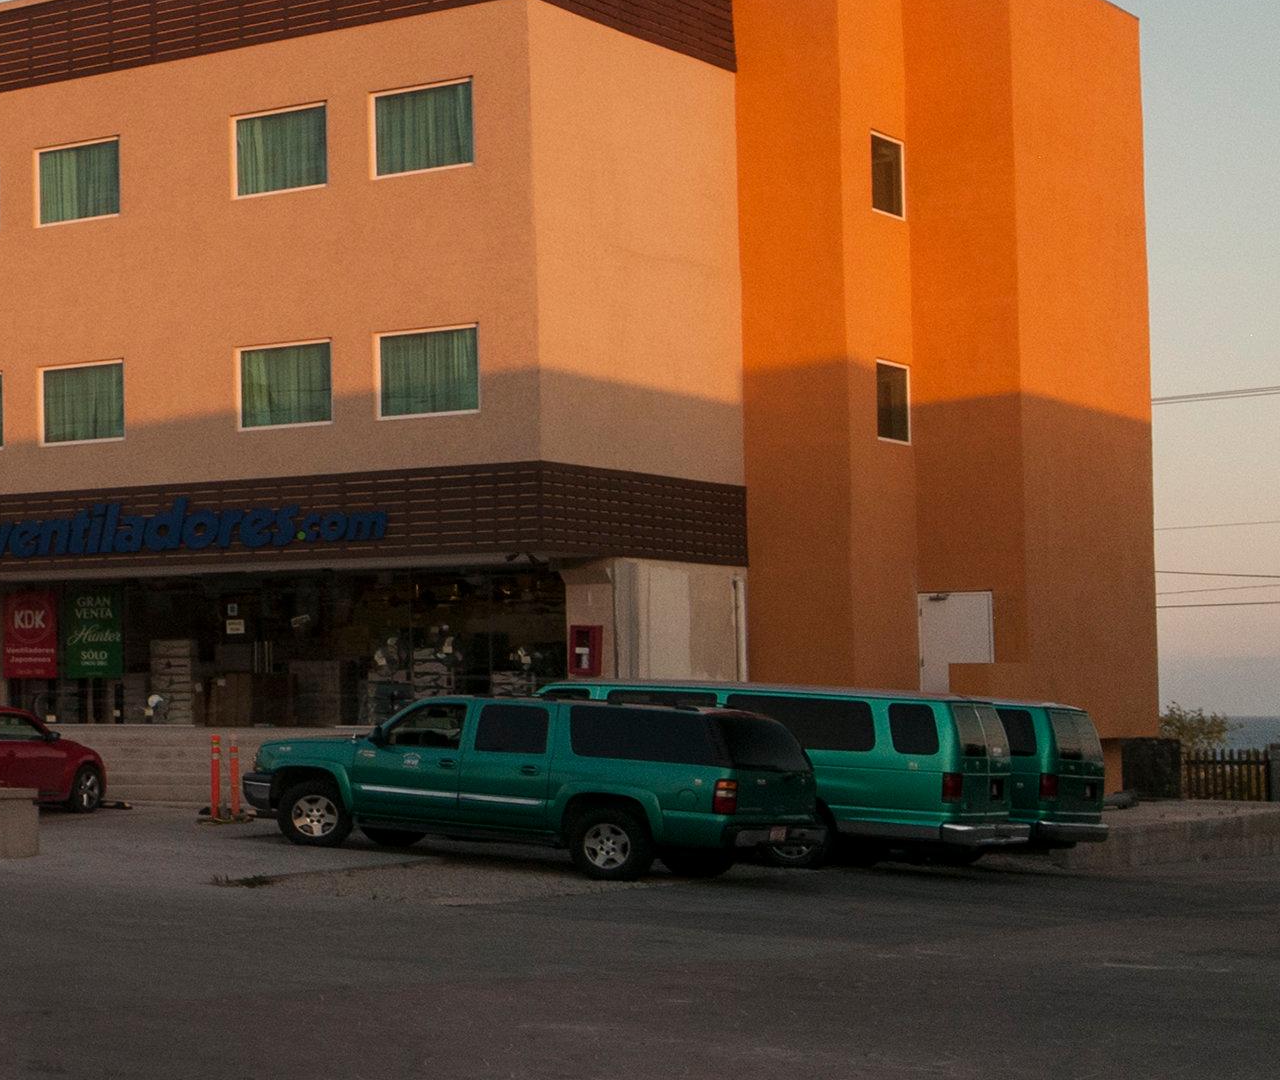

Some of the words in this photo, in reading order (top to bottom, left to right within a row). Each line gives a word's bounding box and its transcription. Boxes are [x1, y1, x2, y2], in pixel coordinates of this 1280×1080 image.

[77, 596, 111, 607] GRAN
[14, 609, 46, 629] KDK
[75, 607, 113, 619] VENTA
[68, 624, 121, 646] Hunter
